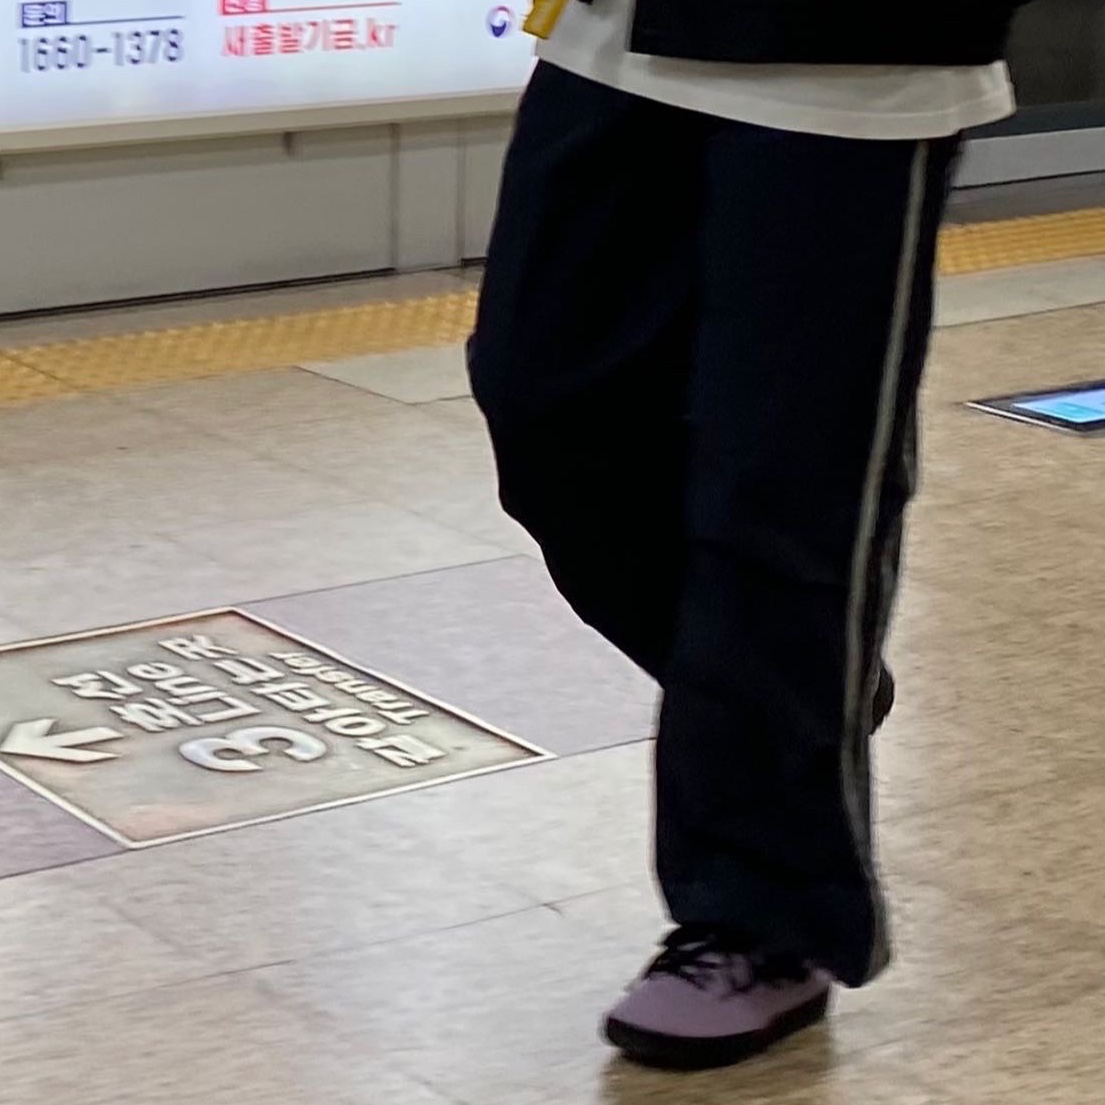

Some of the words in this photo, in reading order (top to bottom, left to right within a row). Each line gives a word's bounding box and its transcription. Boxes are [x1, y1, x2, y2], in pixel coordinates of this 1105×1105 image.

[18, 28, 185, 74] 1660-1378
[222, 17, 400, 57] 새출발기금.kr
[126, 661, 263, 727] Line
[268, 651, 430, 726] Transfer
[179, 725, 328, 772] 3
